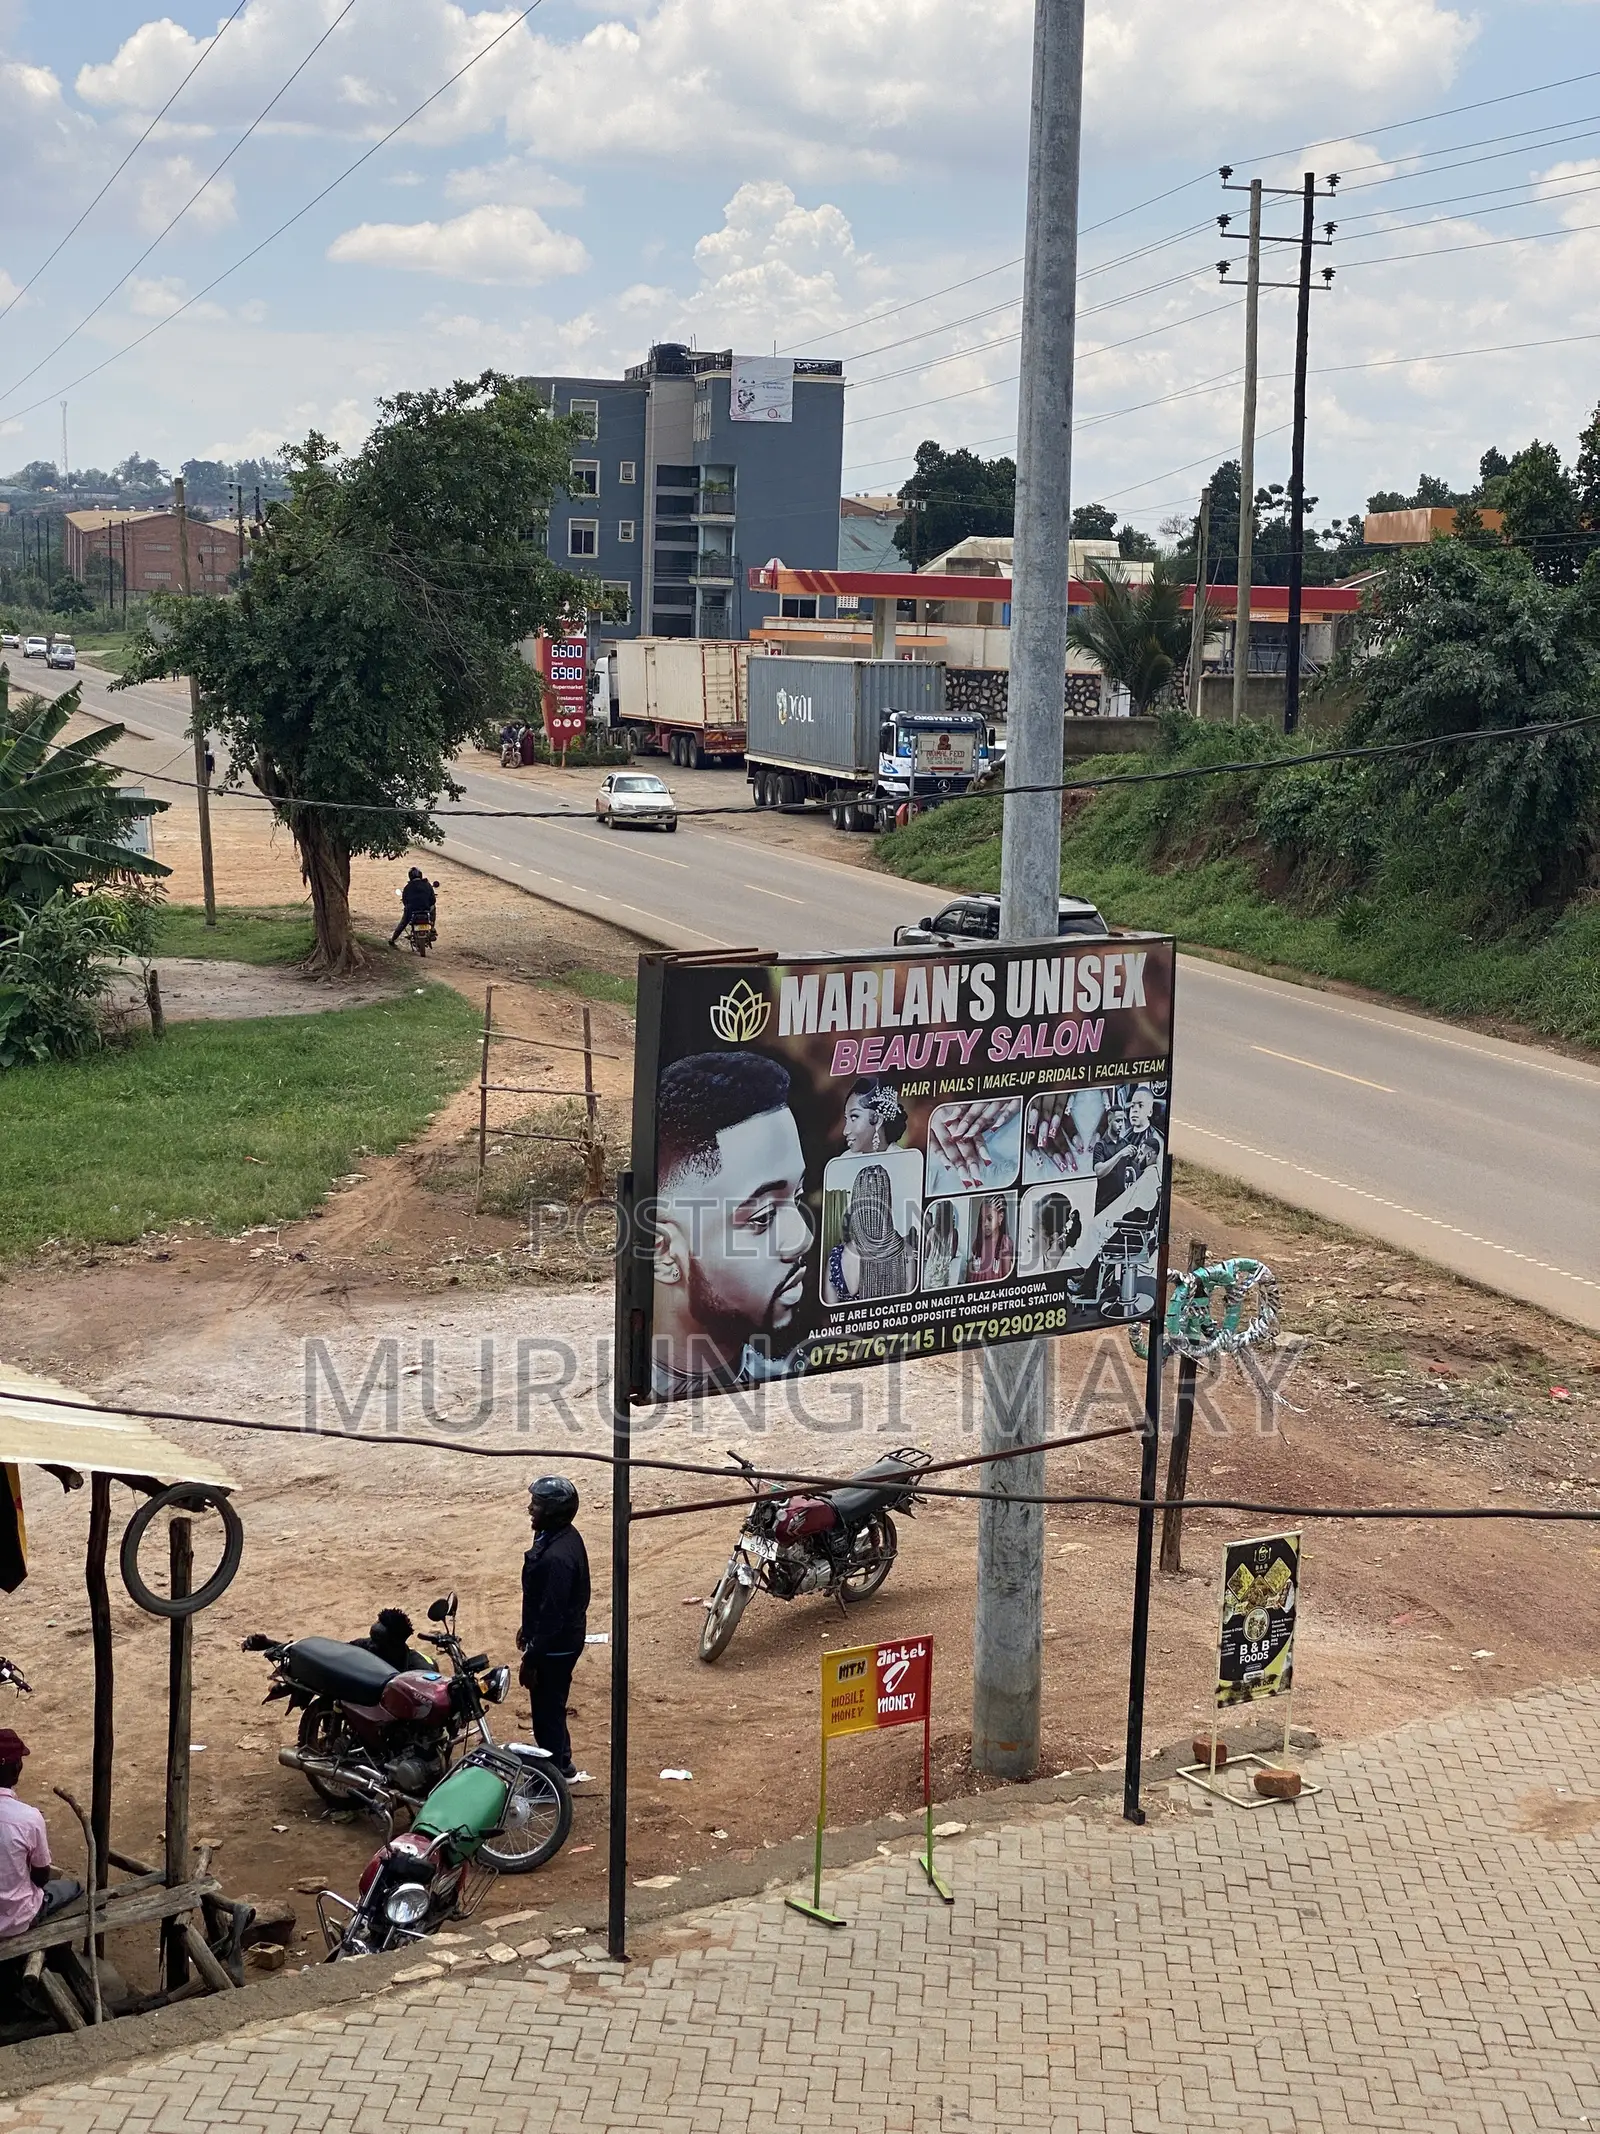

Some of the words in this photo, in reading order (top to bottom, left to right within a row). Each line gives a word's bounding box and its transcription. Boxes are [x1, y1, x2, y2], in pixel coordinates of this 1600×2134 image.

[551, 644, 583, 658] 6600
[551, 667, 583, 680] 6980
[778, 962, 996, 1037] MARLAN'S
[1006, 952, 1148, 1018] UNISEX
[830, 1028, 983, 1077] BEAUTY
[987, 1018, 1105, 1062] SALON
[900, 1080, 931, 1097] HAIR
[939, 1077, 975, 1094] NAILS
[982, 1070, 1036, 1089] MAKE-UP
[1037, 1066, 1086, 1084] BRIDALS
[1094, 1062, 1130, 1078] FACIAL
[1131, 1059, 1166, 1075] STEAM
[808, 1325, 843, 1340] ALONG
[845, 1320, 880, 1334] BOMBO
[882, 1316, 909, 1329] ROAD
[910, 1308, 957, 1324] OPPOSITE
[960, 1303, 990, 1317] TORCH
[991, 1300, 1027, 1312] PETROL
[1028, 1291, 1066, 1306] STATION
[829, 1312, 846, 1323] WE
[847, 1309, 868, 1321] ARE
[869, 1302, 913, 1318] LOCATED
[914, 1300, 929, 1310] ON
[930, 1295, 966, 1308] NAGITA
[810, 1328, 935, 1367] 0757767115
[952, 1308, 1067, 1344] 0779290288
[876, 1642, 926, 1667] airtel
[1239, 1643, 1249, 1656] B
[1250, 1642, 1259, 1653] &
[1261, 1640, 1270, 1652] B
[1239, 1651, 1269, 1664] FOODS
[838, 1660, 866, 1680] MTN
[831, 1688, 865, 1709] MOBILE
[877, 1692, 916, 1714] MONEY
[831, 1706, 864, 1724] MONEY
